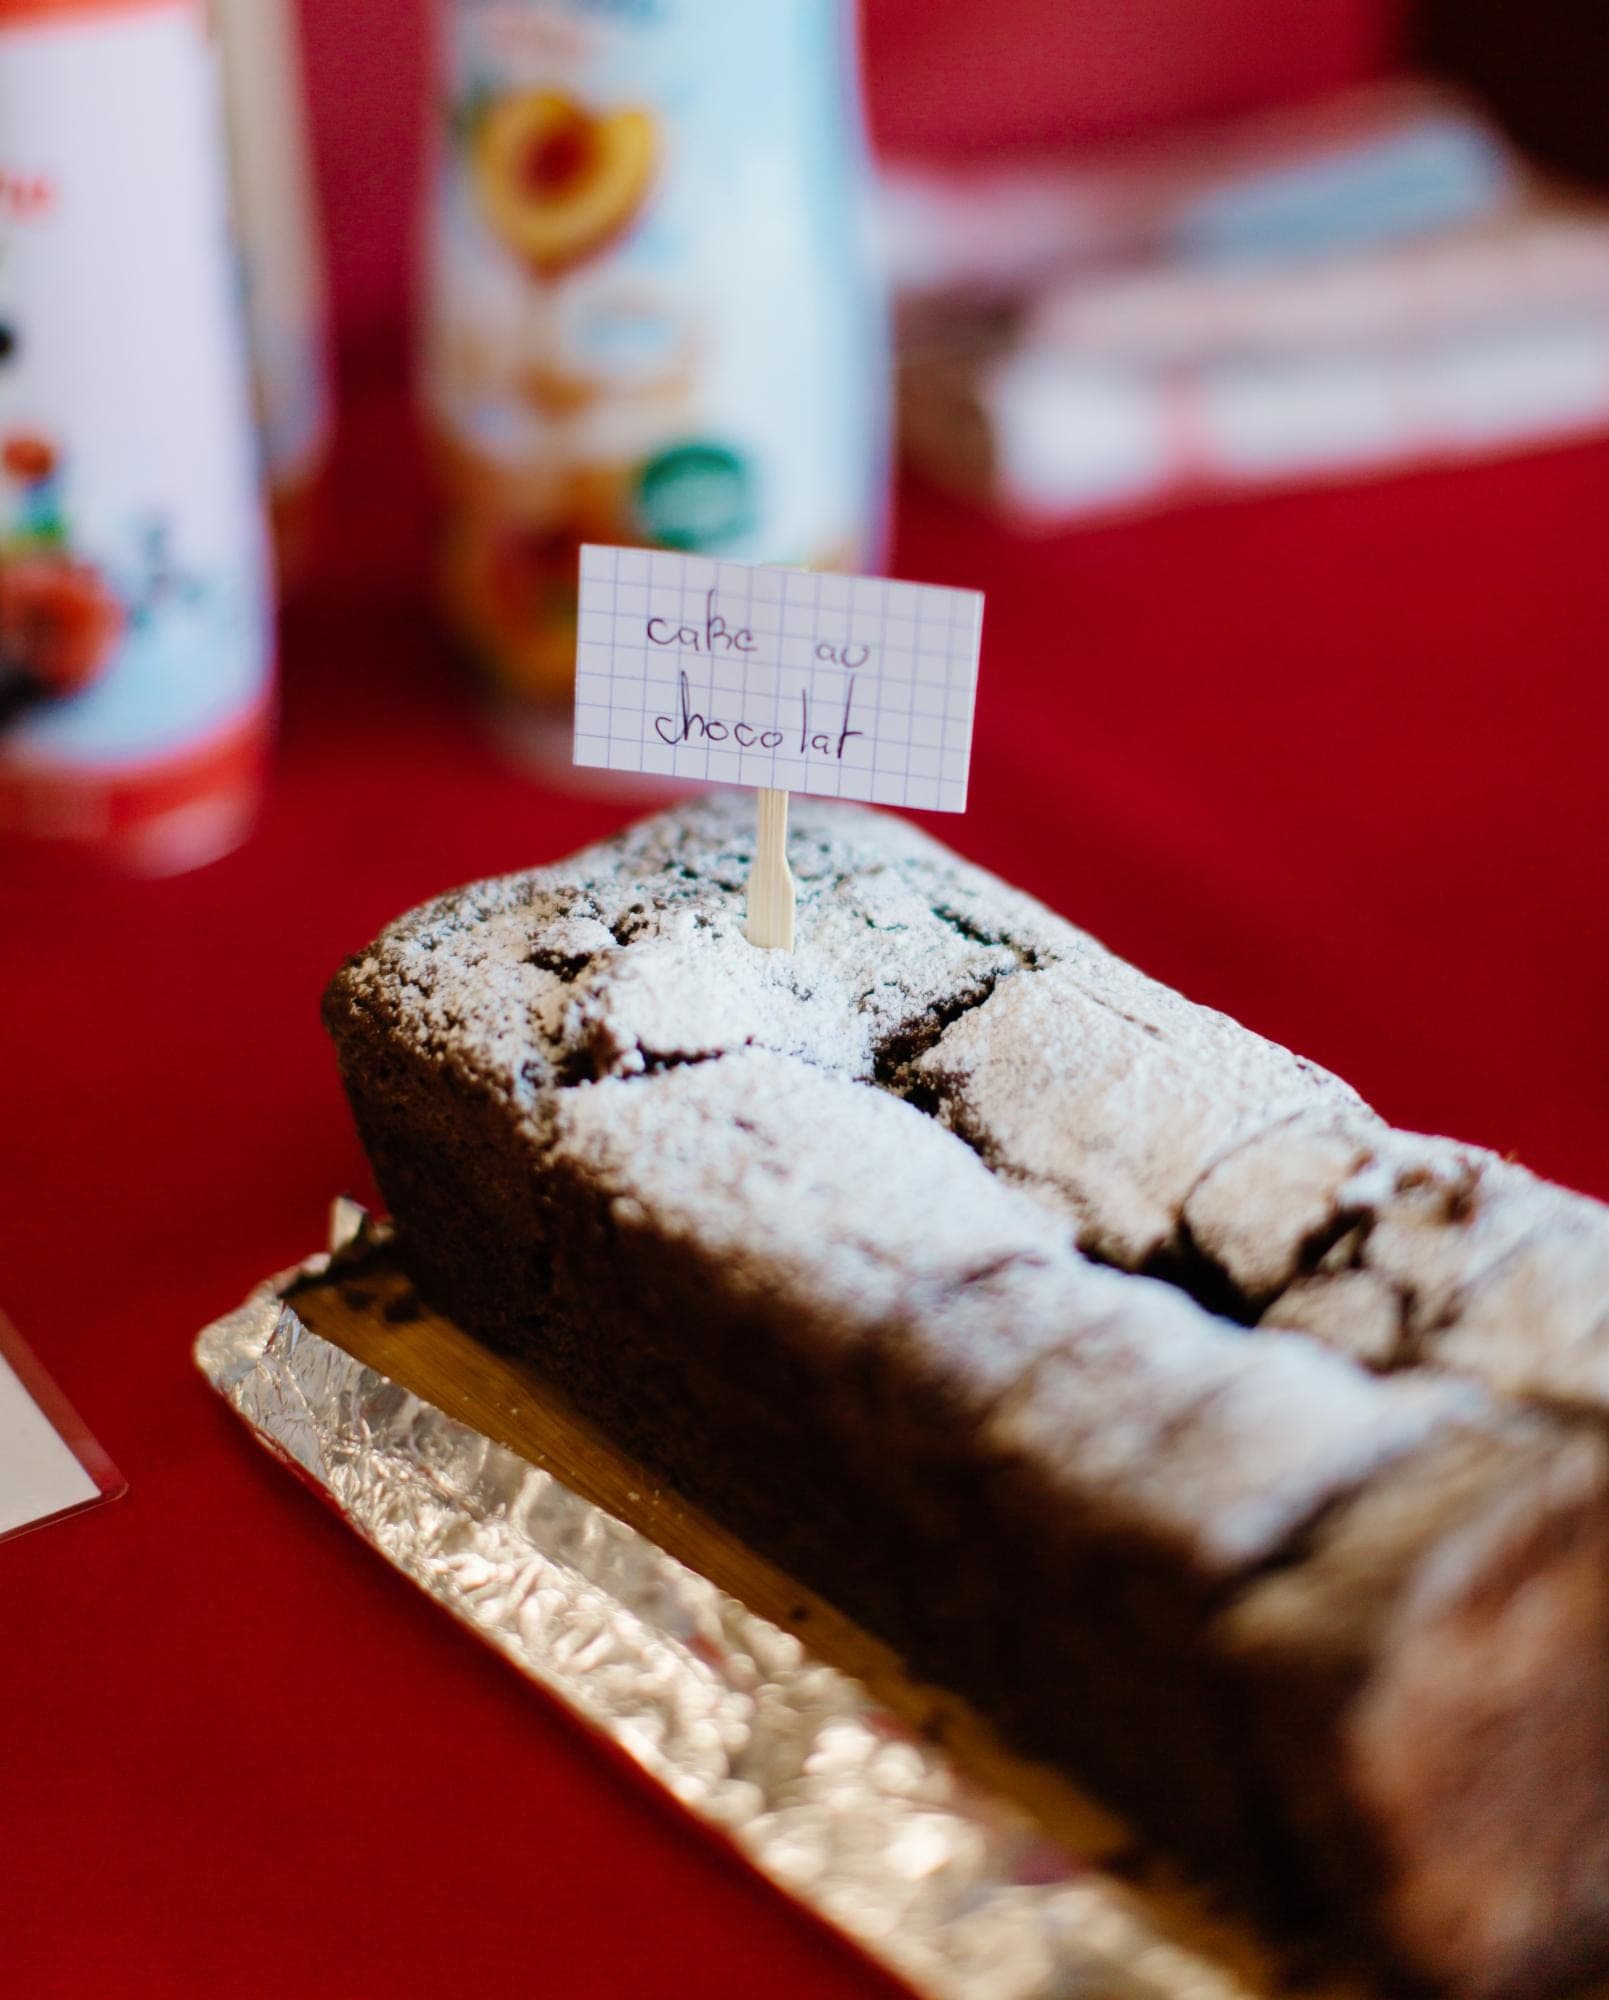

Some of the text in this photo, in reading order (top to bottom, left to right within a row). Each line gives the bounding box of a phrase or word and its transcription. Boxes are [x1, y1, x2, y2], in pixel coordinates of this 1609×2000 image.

[646, 588, 871, 669] cake au
[654, 669, 864, 760] chocolat
